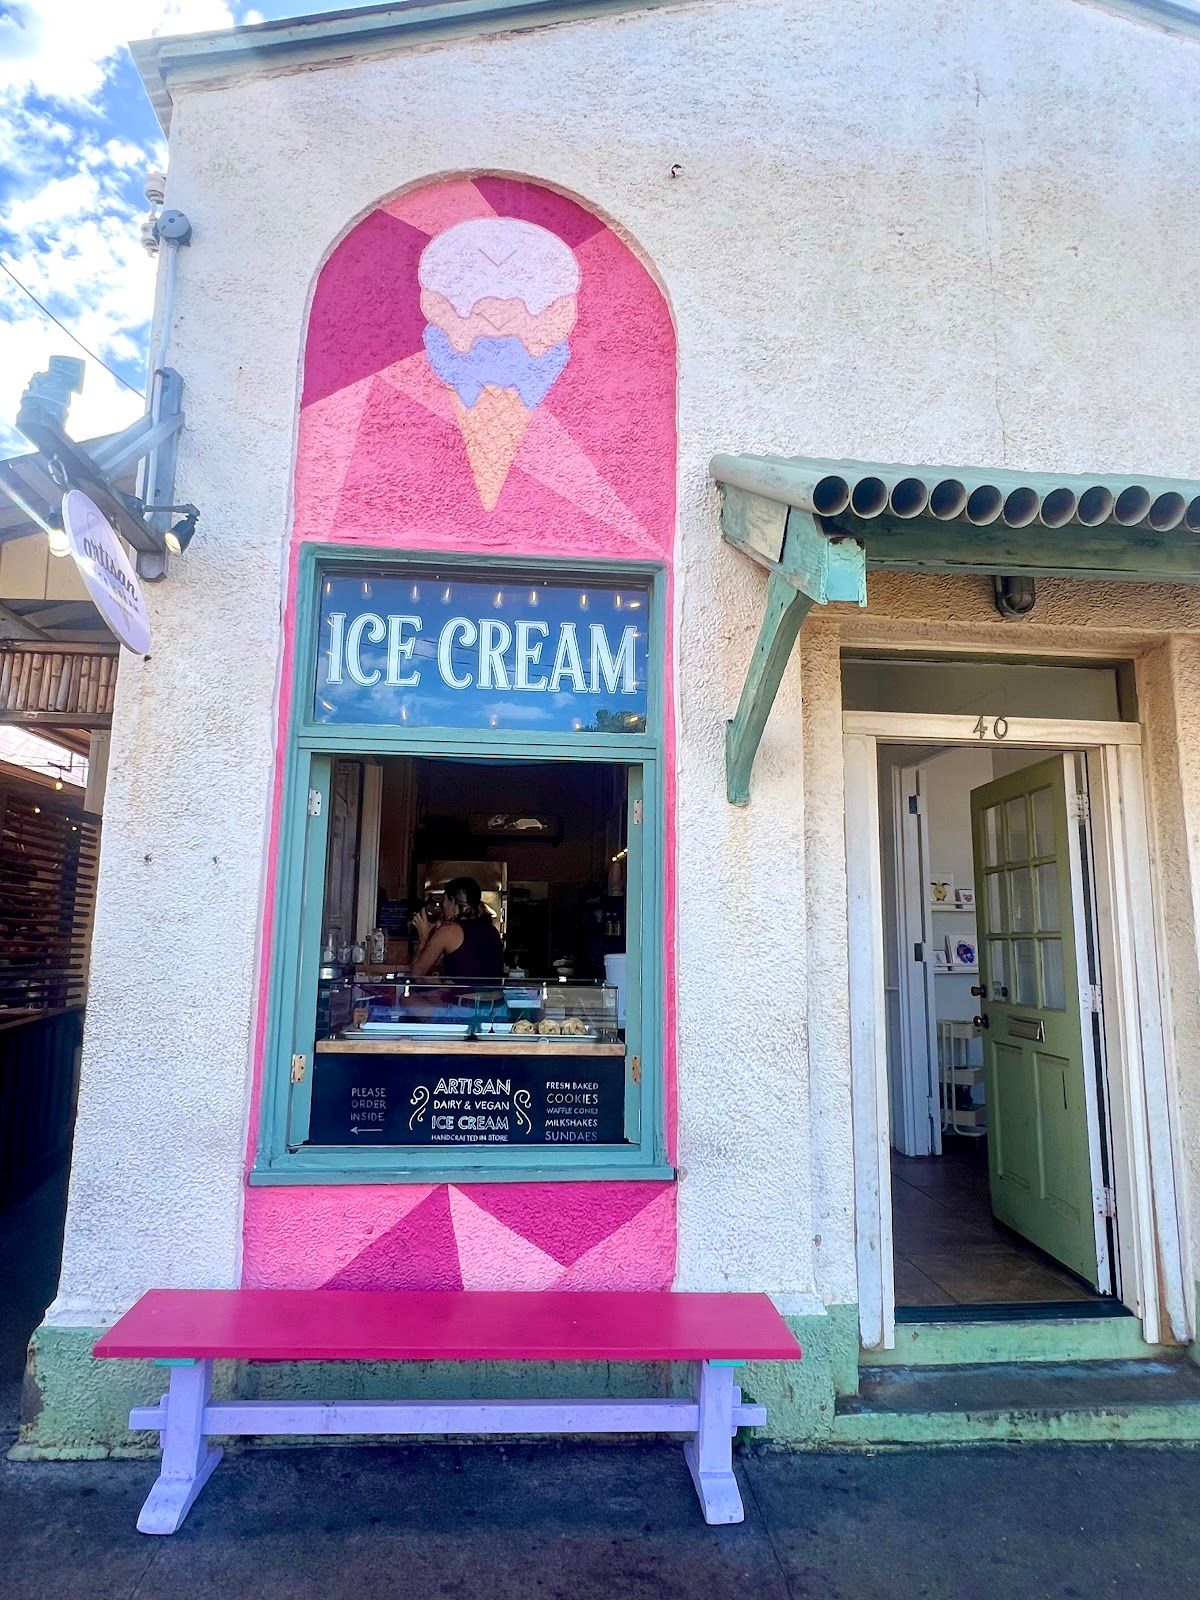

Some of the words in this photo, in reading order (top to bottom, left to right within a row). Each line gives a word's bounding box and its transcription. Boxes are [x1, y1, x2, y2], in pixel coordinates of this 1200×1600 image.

[83, 536, 139, 602] artisan
[326, 612, 423, 687] ICE
[437, 616, 638, 694] CREAM
[972, 714, 1008, 740] 40
[433, 1077, 511, 1095] ARTISAN
[546, 1081, 571, 1090] FRESH
[572, 1081, 599, 1090] BAKED
[351, 1087, 387, 1098] PLEASE
[351, 1099, 387, 1110] ORDER
[433, 1099, 462, 1110] DAIRY
[463, 1100, 472, 1111] &
[474, 1100, 510, 1111] VEGAN
[546, 1093, 599, 1105] COOKIES
[350, 1111, 385, 1122] INSIDE
[546, 1107, 573, 1115] WAFFLE
[431, 1114, 455, 1130] ICE
[457, 1115, 510, 1131] CREAM
[545, 1118, 598, 1128] MILKSHAKES
[487, 1134, 509, 1142] STORE
[544, 1130, 598, 1142] SUNDAES
